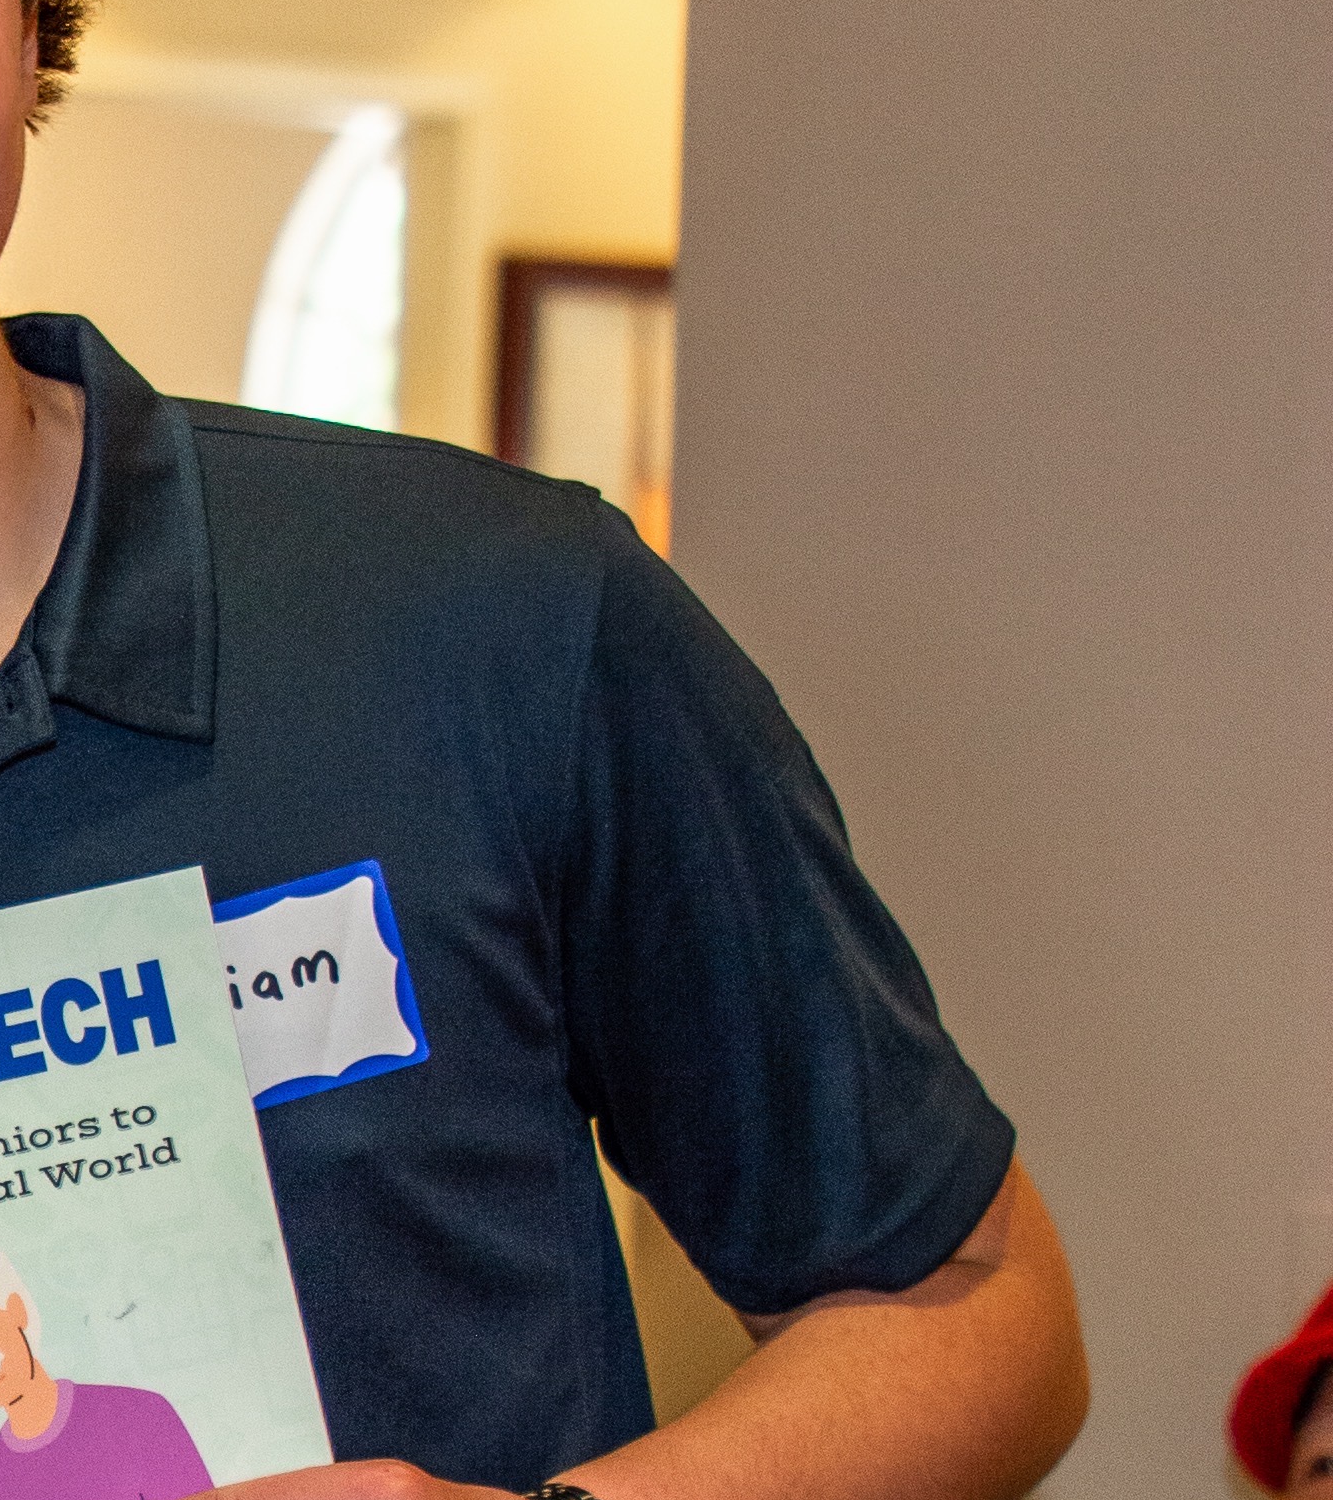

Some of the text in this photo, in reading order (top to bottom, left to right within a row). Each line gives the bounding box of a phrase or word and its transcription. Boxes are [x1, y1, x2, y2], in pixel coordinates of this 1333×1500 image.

[226, 949, 339, 1010] iam
[110, 1104, 159, 1131] to
[41, 1136, 181, 1190] World
